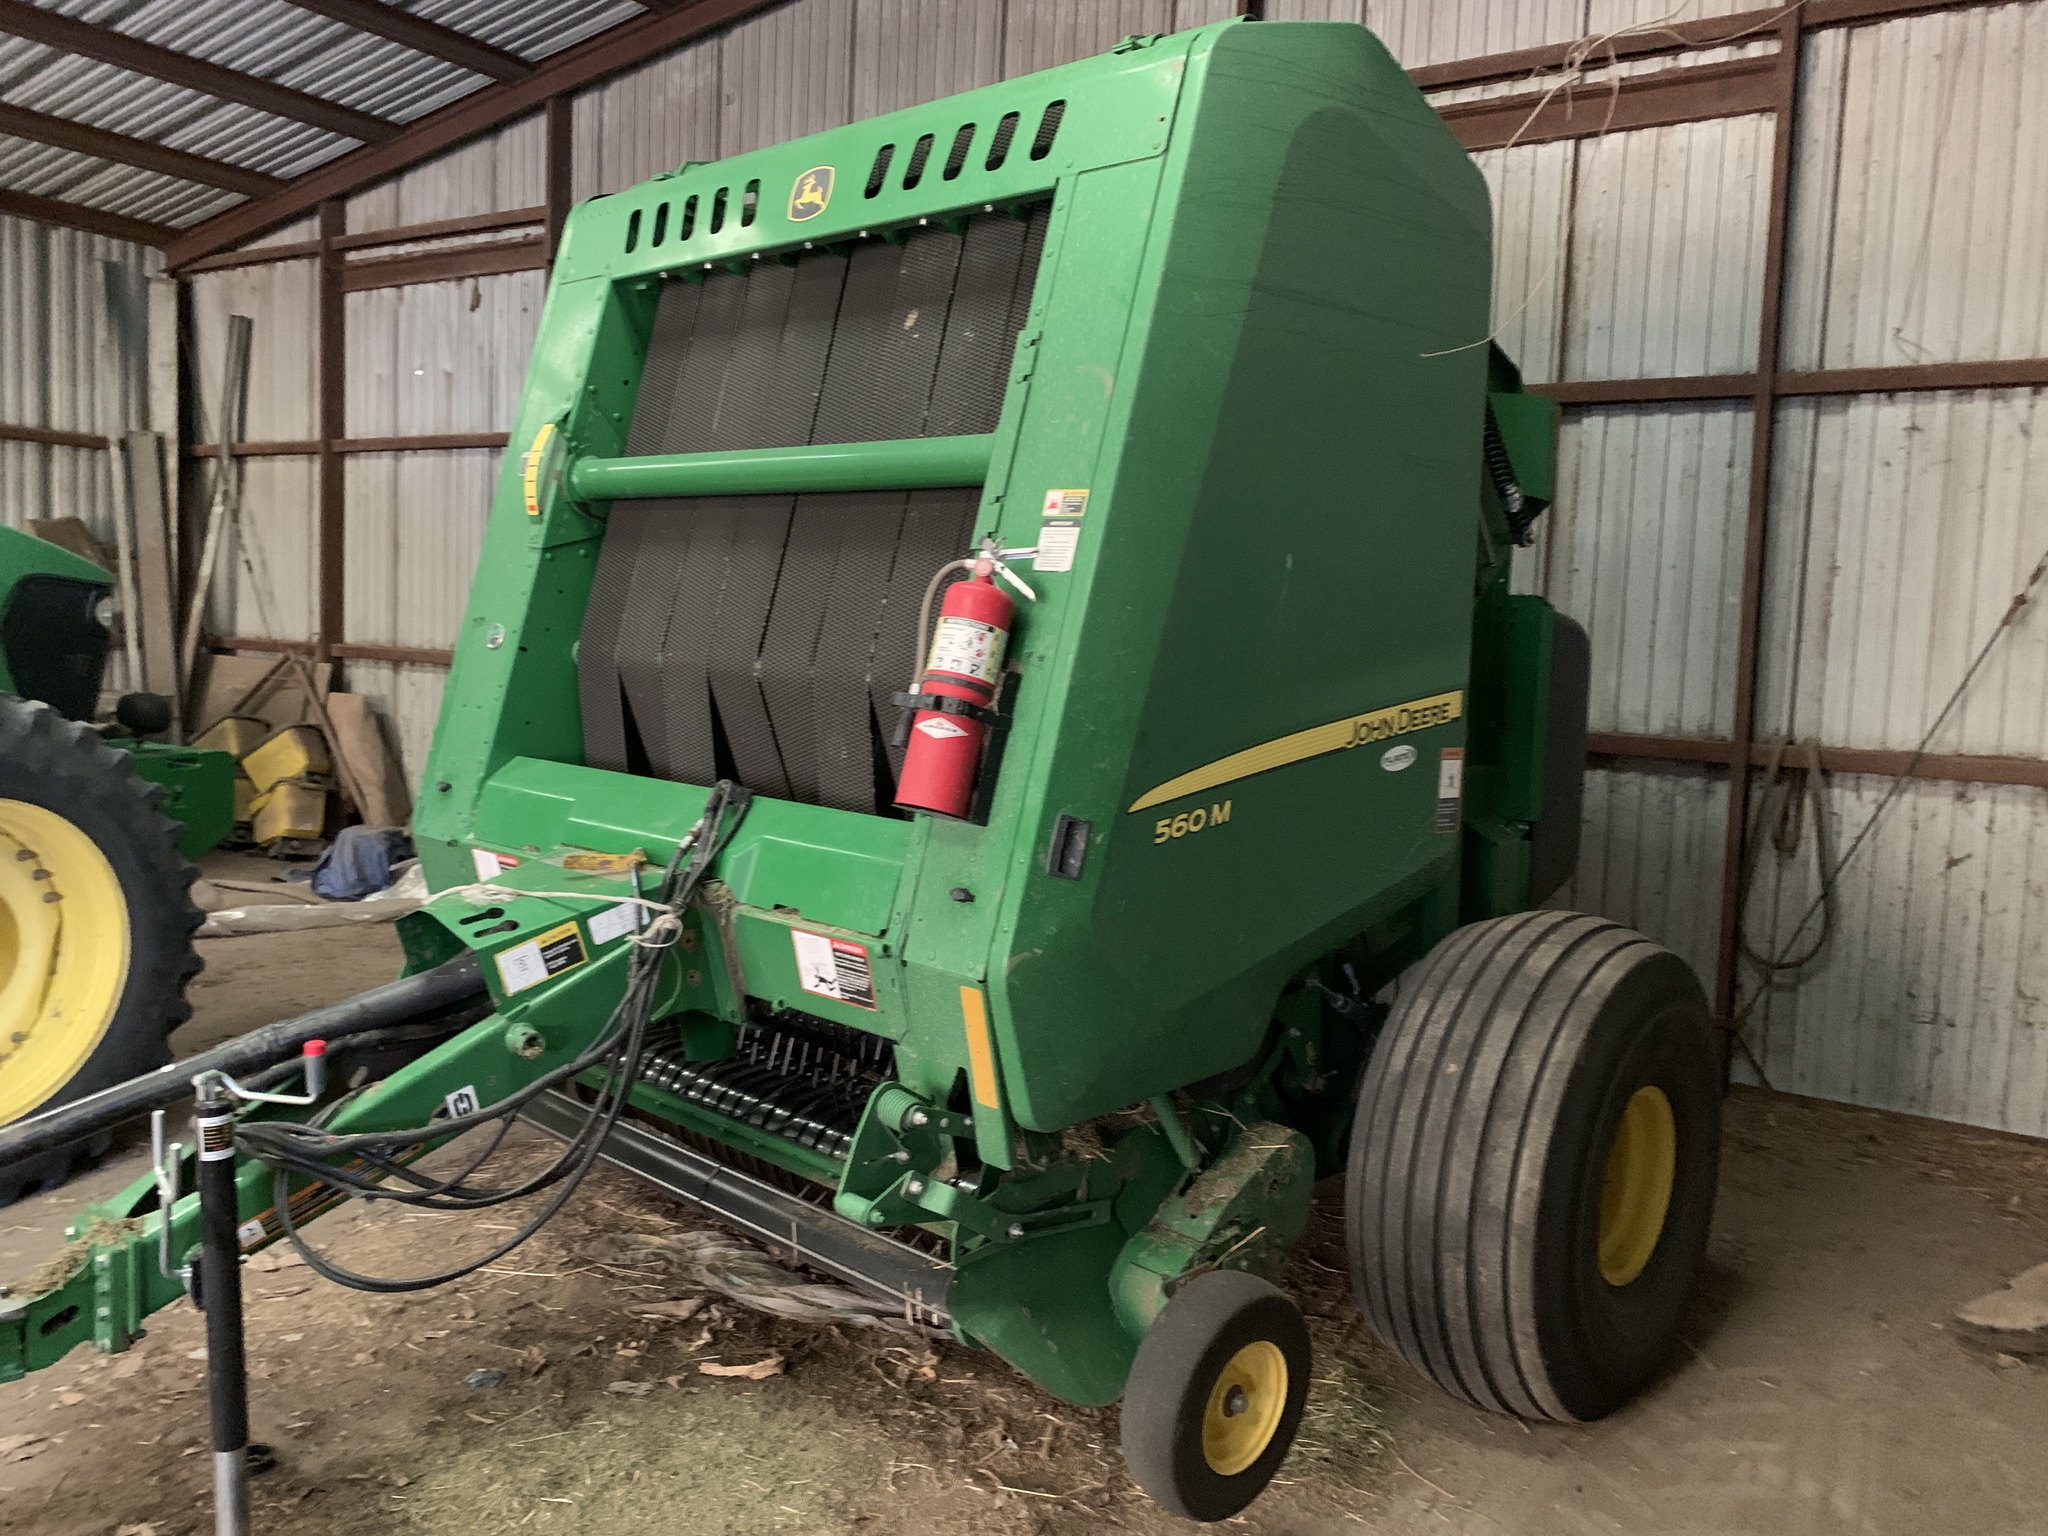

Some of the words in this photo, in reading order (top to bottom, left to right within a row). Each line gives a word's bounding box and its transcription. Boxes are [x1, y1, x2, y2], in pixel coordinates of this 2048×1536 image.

[1346, 715, 1396, 746] JOHN
[1398, 702, 1451, 731] DEERE
[1153, 807, 1207, 844] 560
[1209, 799, 1232, 827] M
